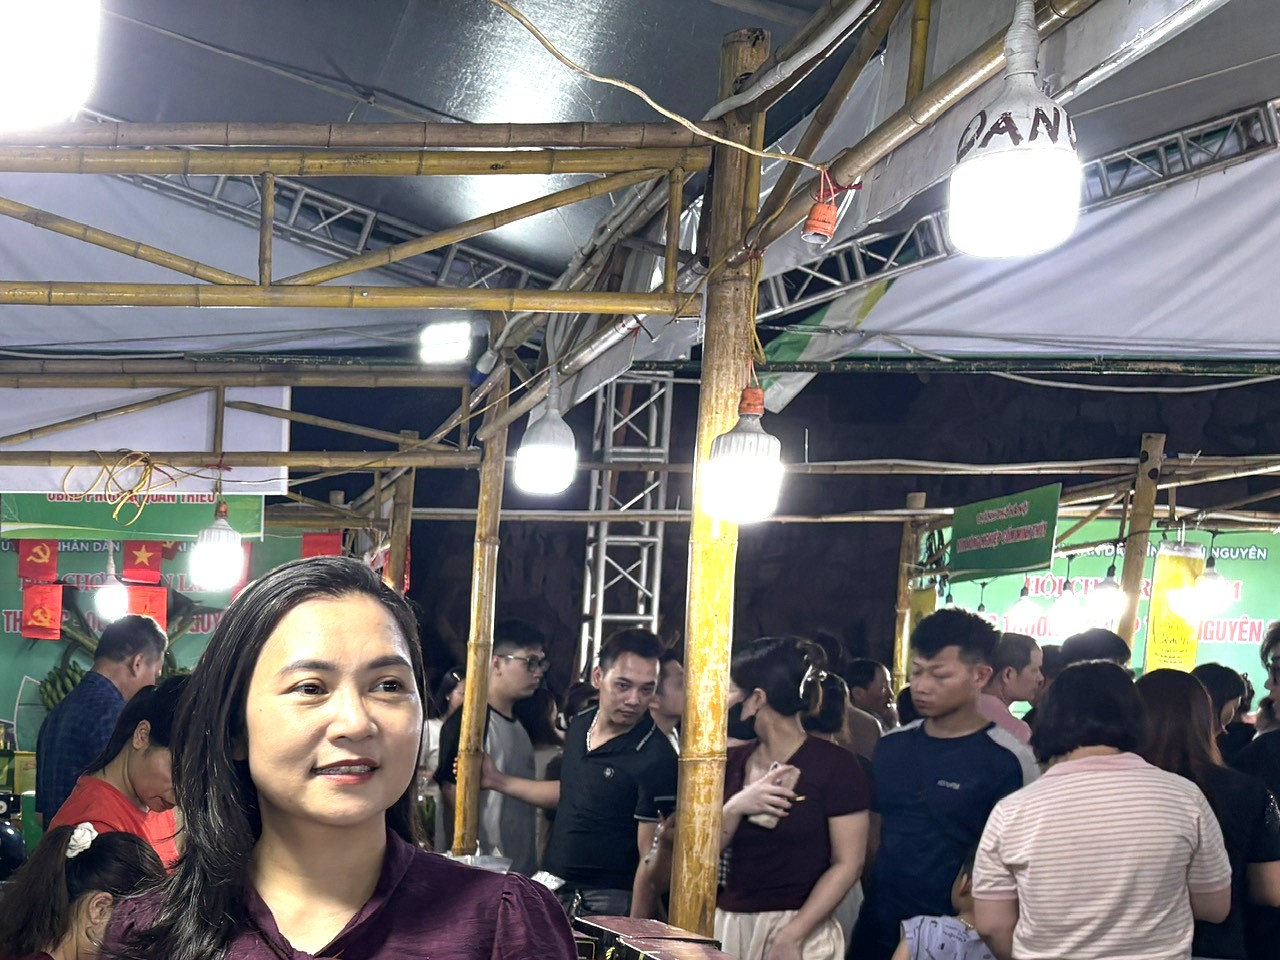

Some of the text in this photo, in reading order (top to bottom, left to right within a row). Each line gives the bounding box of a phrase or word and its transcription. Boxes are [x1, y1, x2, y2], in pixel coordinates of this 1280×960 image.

[92, 540, 121, 553] DÂN
[1210, 543, 1268, 561] NGUYÊN
[1025, 573, 1063, 599] HỘI
